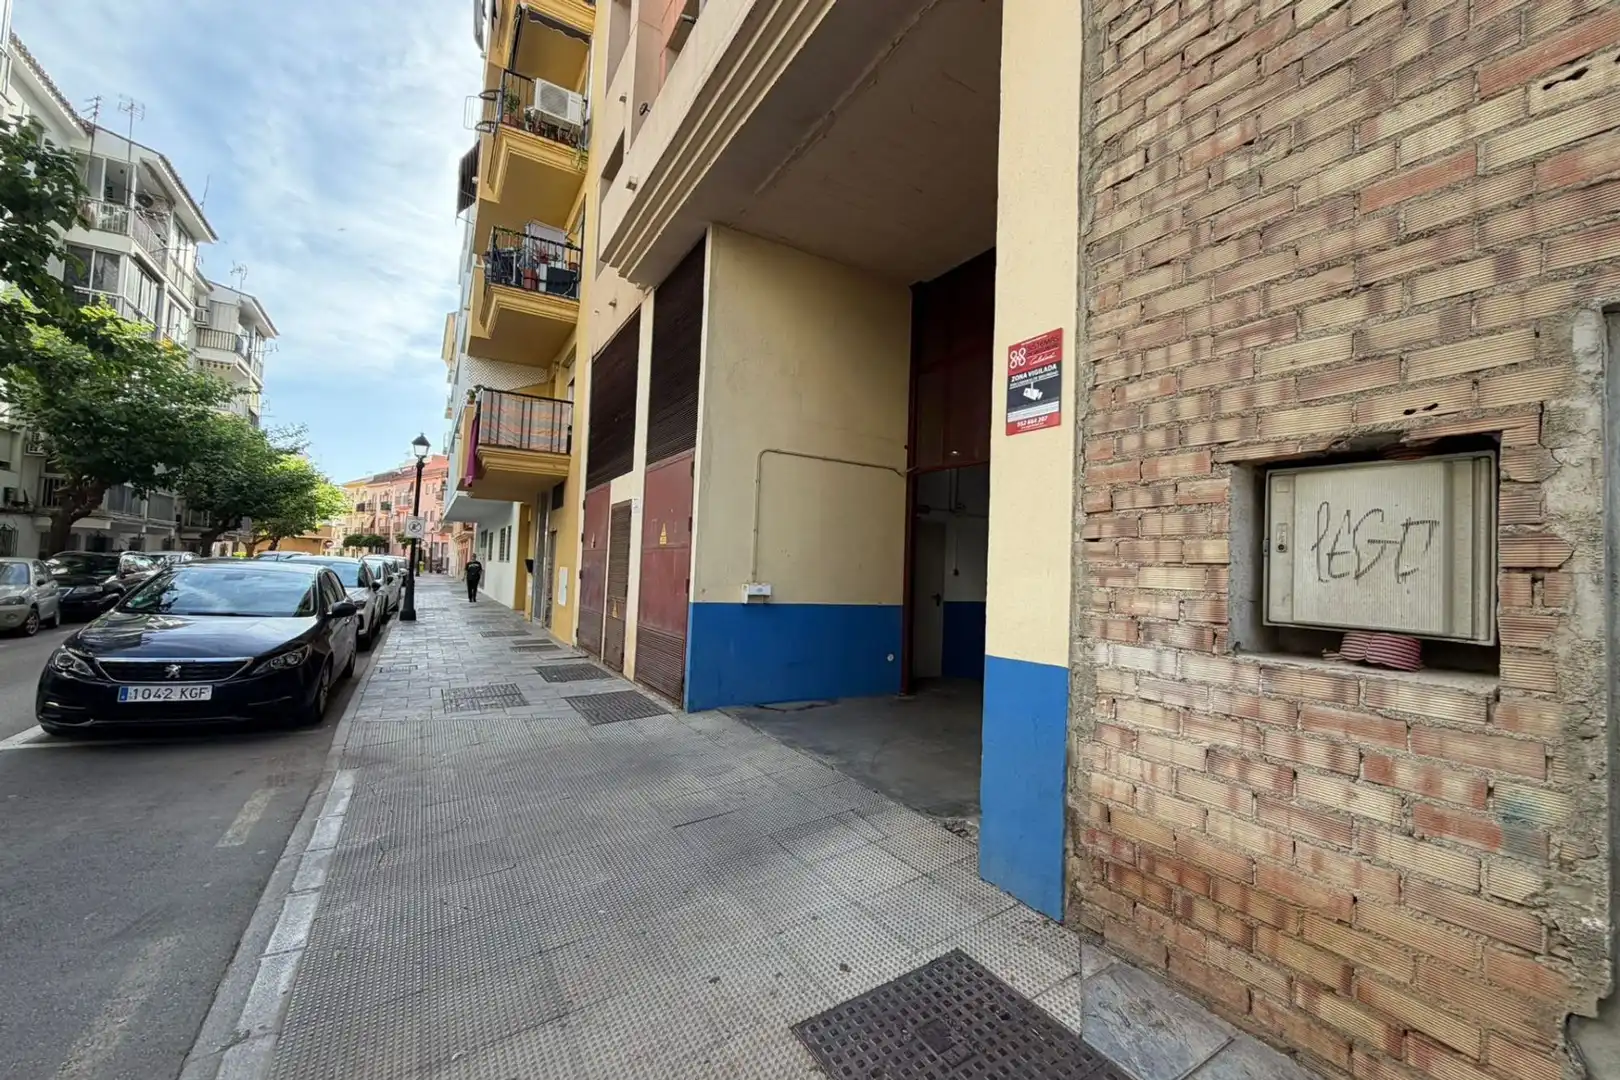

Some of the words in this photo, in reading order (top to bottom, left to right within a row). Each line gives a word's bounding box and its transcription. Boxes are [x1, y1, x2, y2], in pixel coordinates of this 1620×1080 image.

[1011, 372, 1028, 382] ZONA
[1028, 363, 1057, 378] VIGILADA
[133, 687, 173, 700] 1042
[180, 687, 208, 700] KGF
